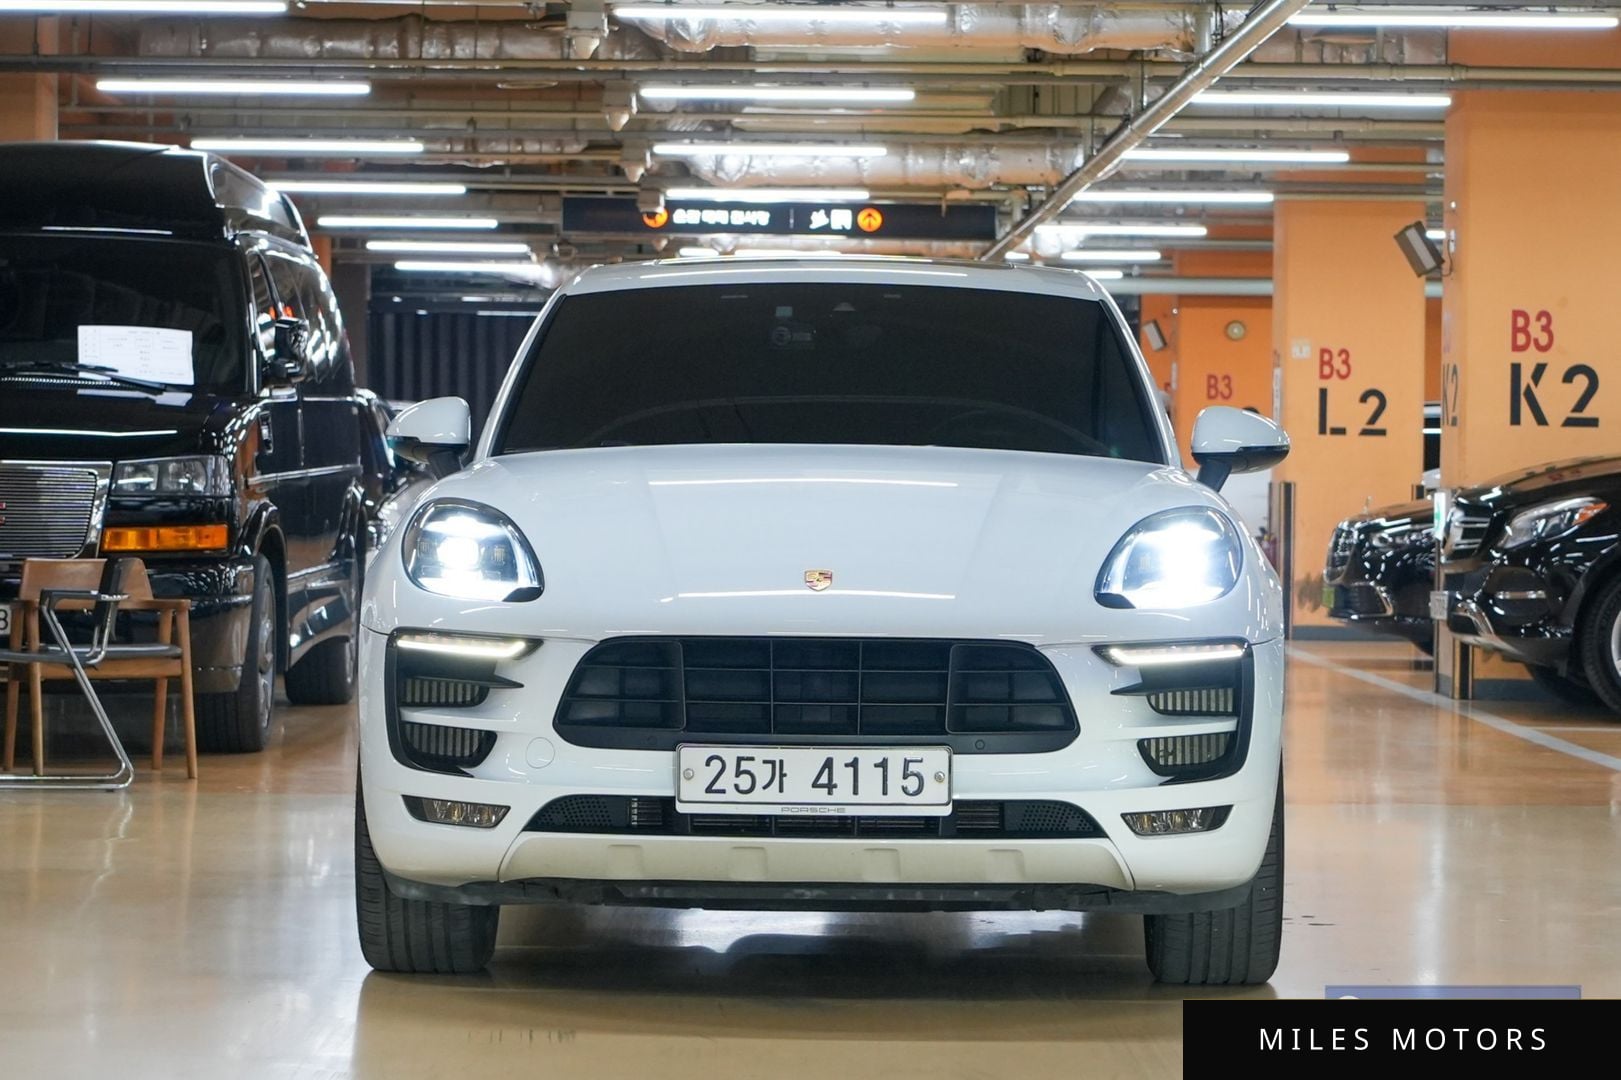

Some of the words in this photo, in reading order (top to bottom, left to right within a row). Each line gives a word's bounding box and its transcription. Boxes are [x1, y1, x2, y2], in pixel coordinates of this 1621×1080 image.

[1511, 309, 1554, 353] B3
[1318, 348, 1352, 380] B3
[1206, 374, 1233, 400] B3
[1510, 362, 1600, 428] K2
[1318, 387, 1387, 437] L2
[704, 754, 788, 795] 25가
[811, 756, 925, 797] 4115
[780, 806, 846, 814] PORSCHE
